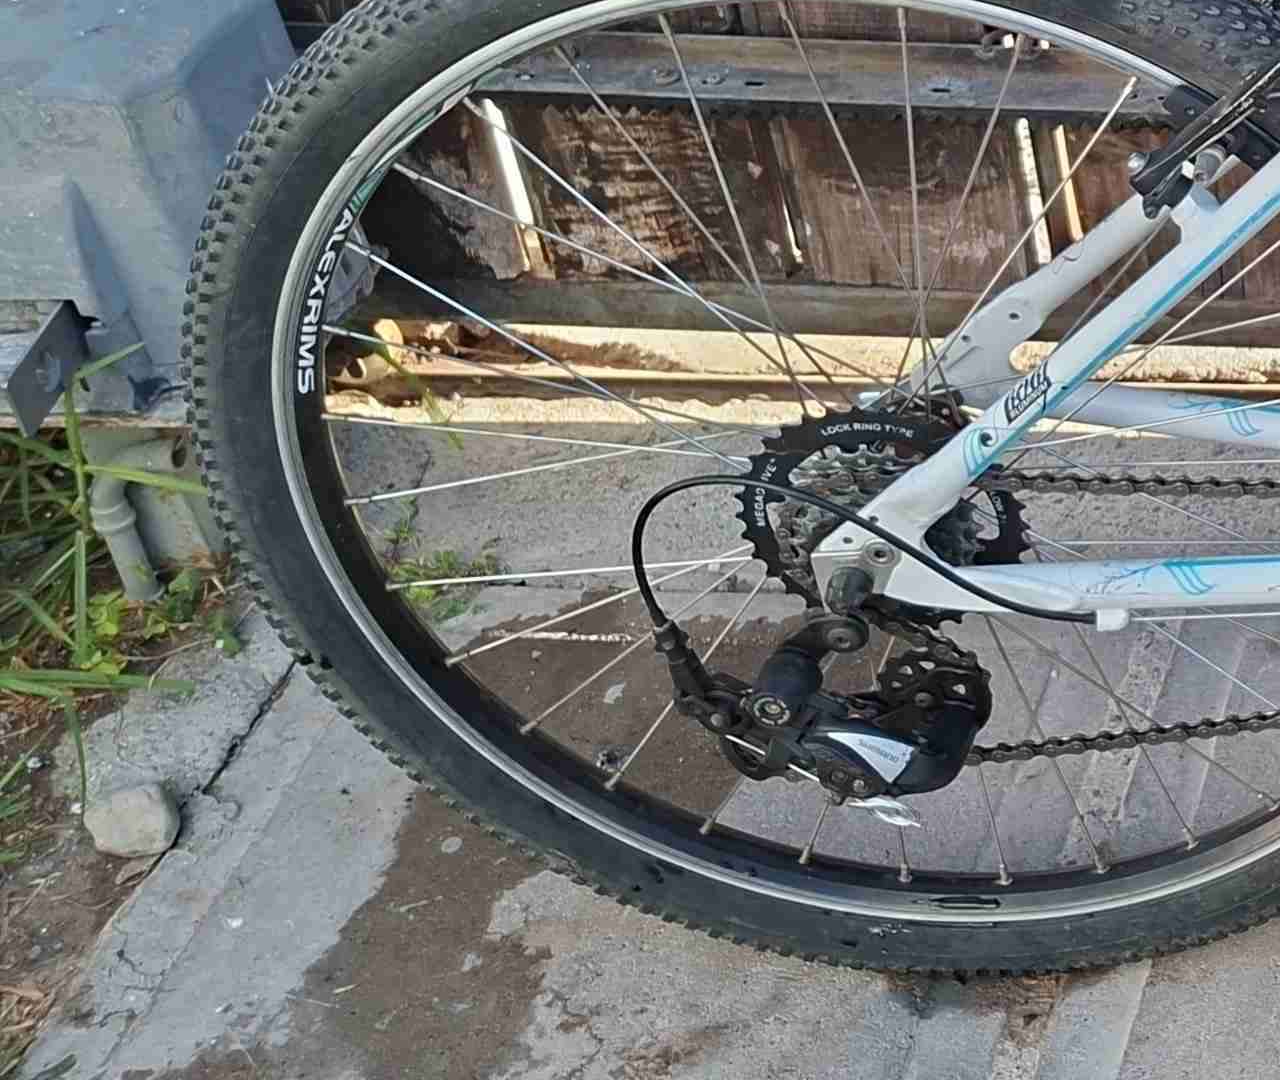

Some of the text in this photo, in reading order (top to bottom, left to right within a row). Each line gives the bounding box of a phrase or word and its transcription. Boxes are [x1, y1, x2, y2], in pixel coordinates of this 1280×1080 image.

[820, 422, 915, 438] LOCK RING TYPE
